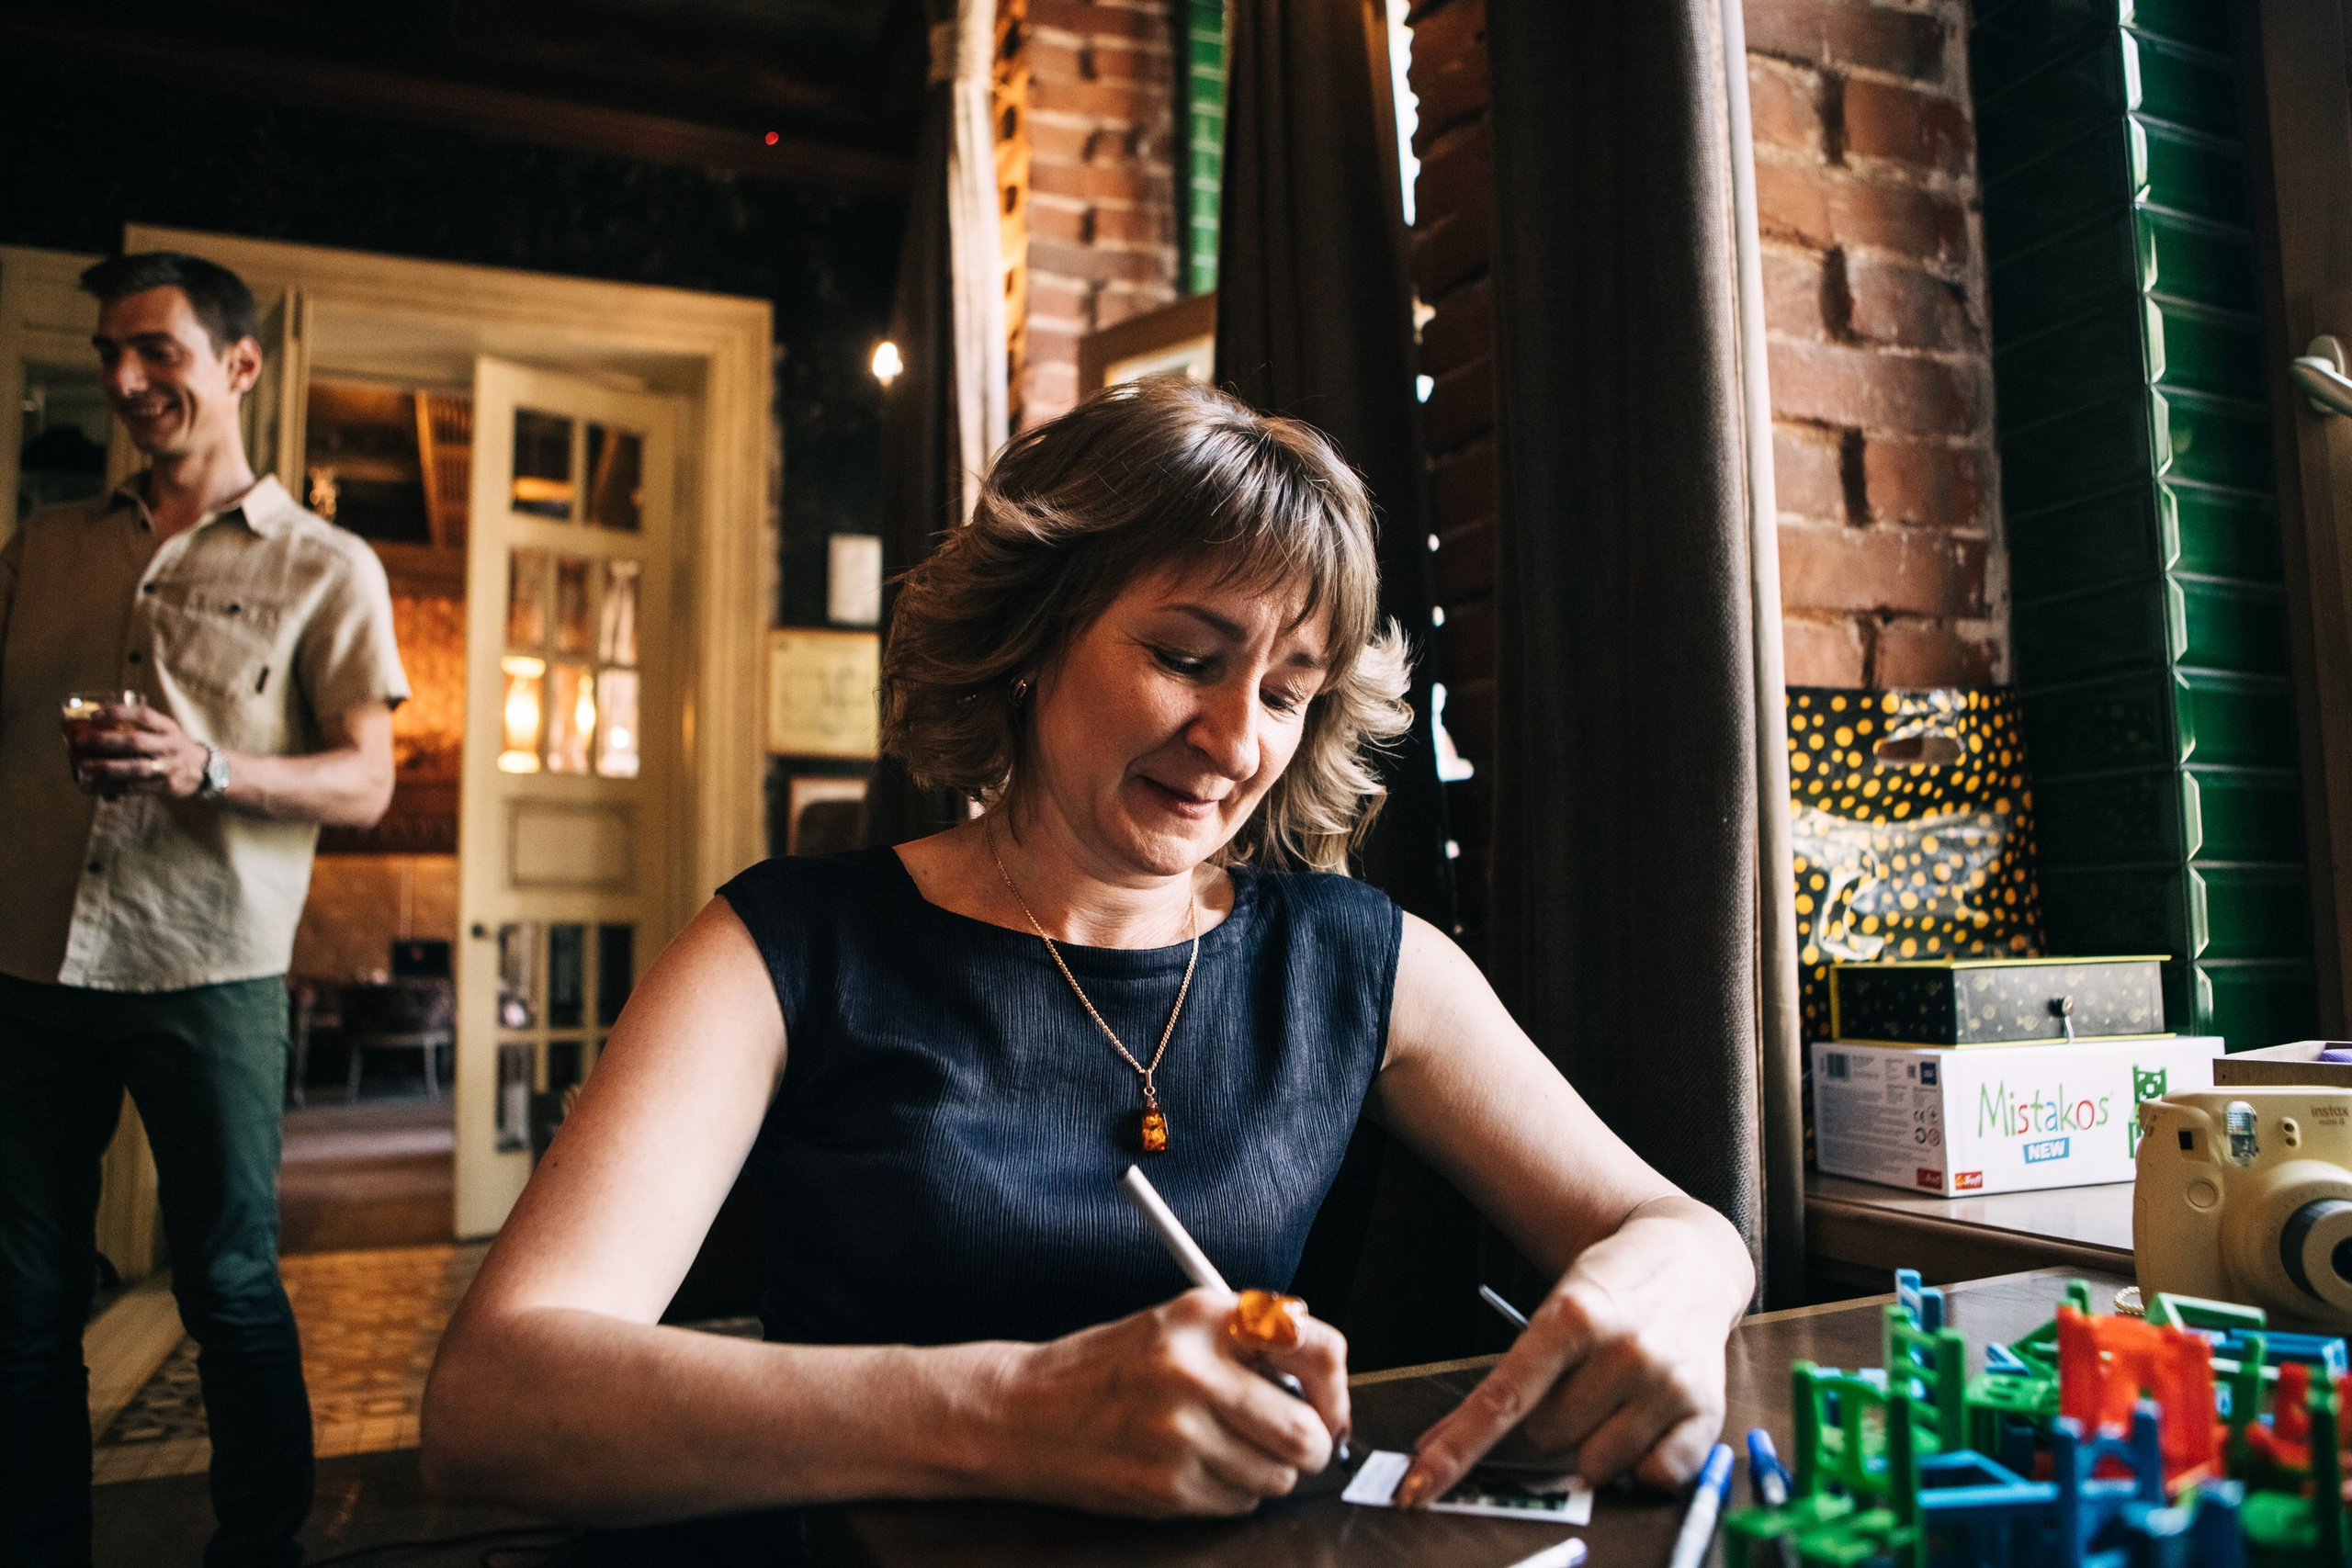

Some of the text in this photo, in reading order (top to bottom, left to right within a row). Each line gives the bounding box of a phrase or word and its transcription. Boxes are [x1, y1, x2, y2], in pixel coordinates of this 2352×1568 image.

[1978, 1080, 2109, 1139] Mistakos
[2311, 1105, 2348, 1117] instax
[2028, 1139, 2066, 1161] NEW
